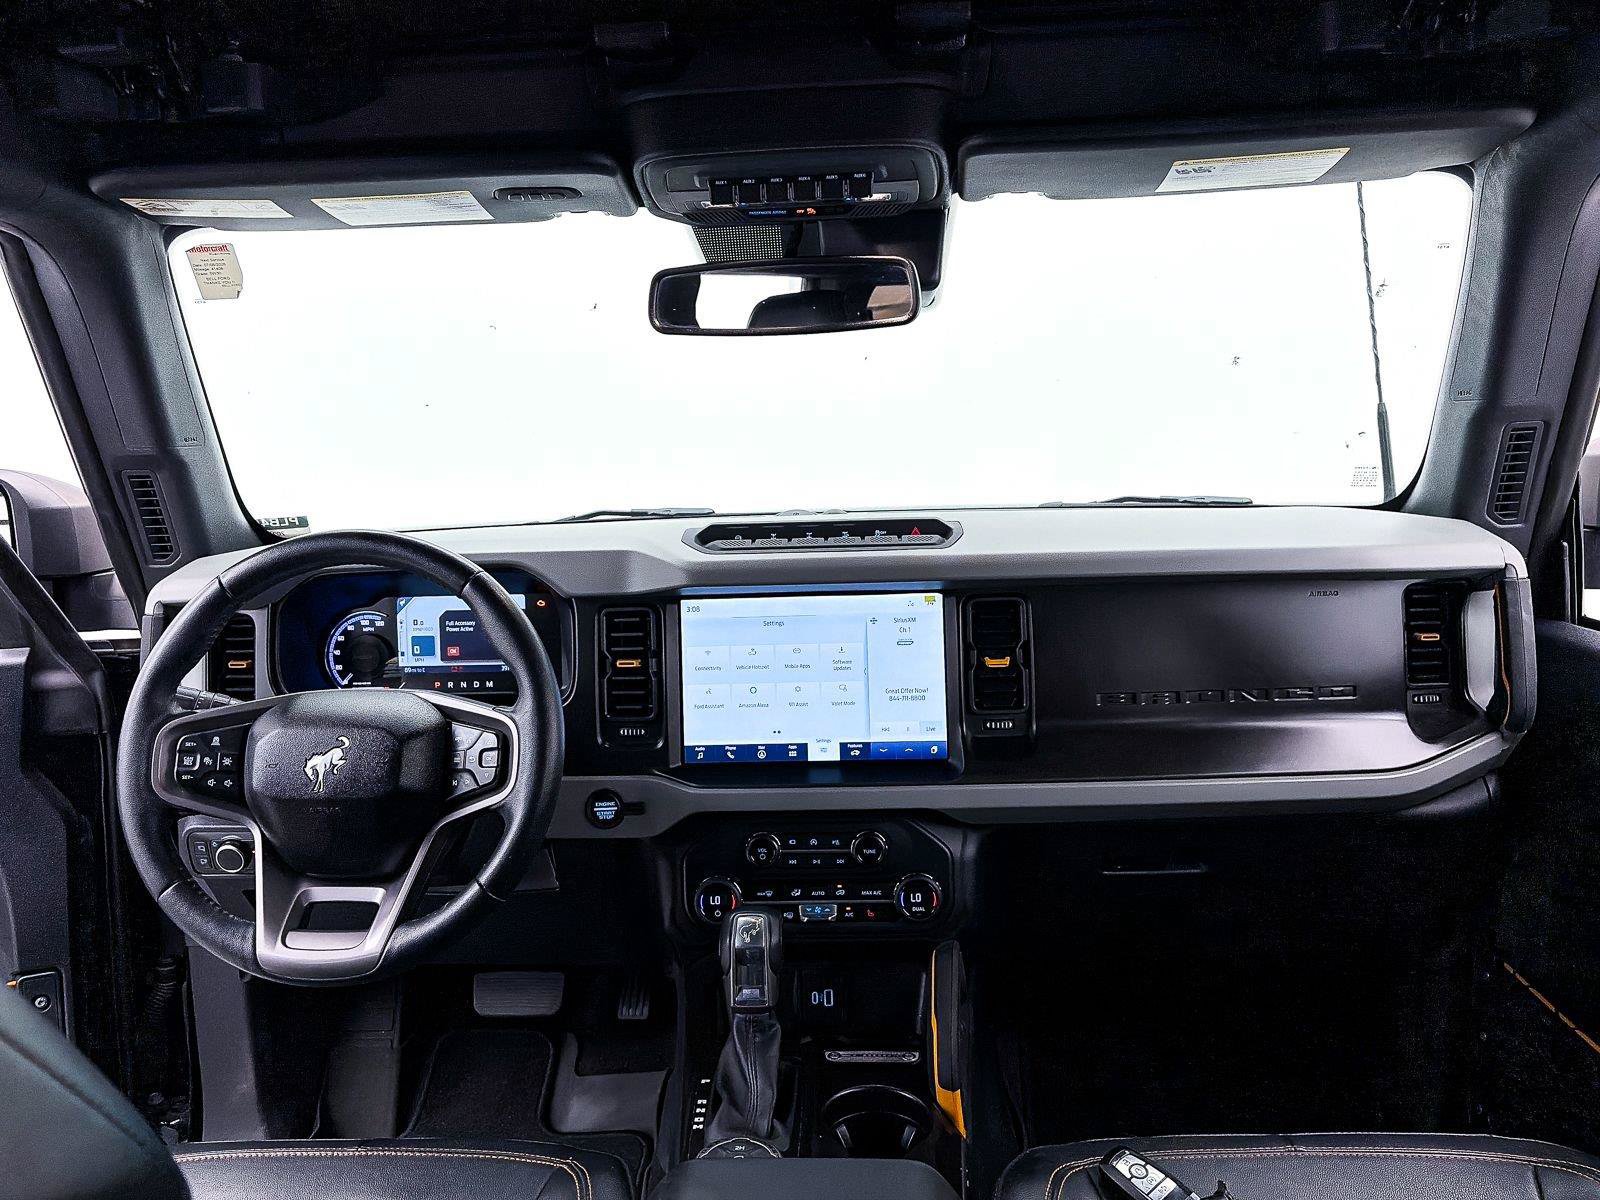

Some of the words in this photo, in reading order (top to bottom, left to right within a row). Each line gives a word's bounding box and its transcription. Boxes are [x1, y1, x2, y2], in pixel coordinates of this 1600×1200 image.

[763, 619, 785, 628] Settings
[753, 663, 770, 671] Hotspot
[1095, 685, 1358, 706] BRONCO
